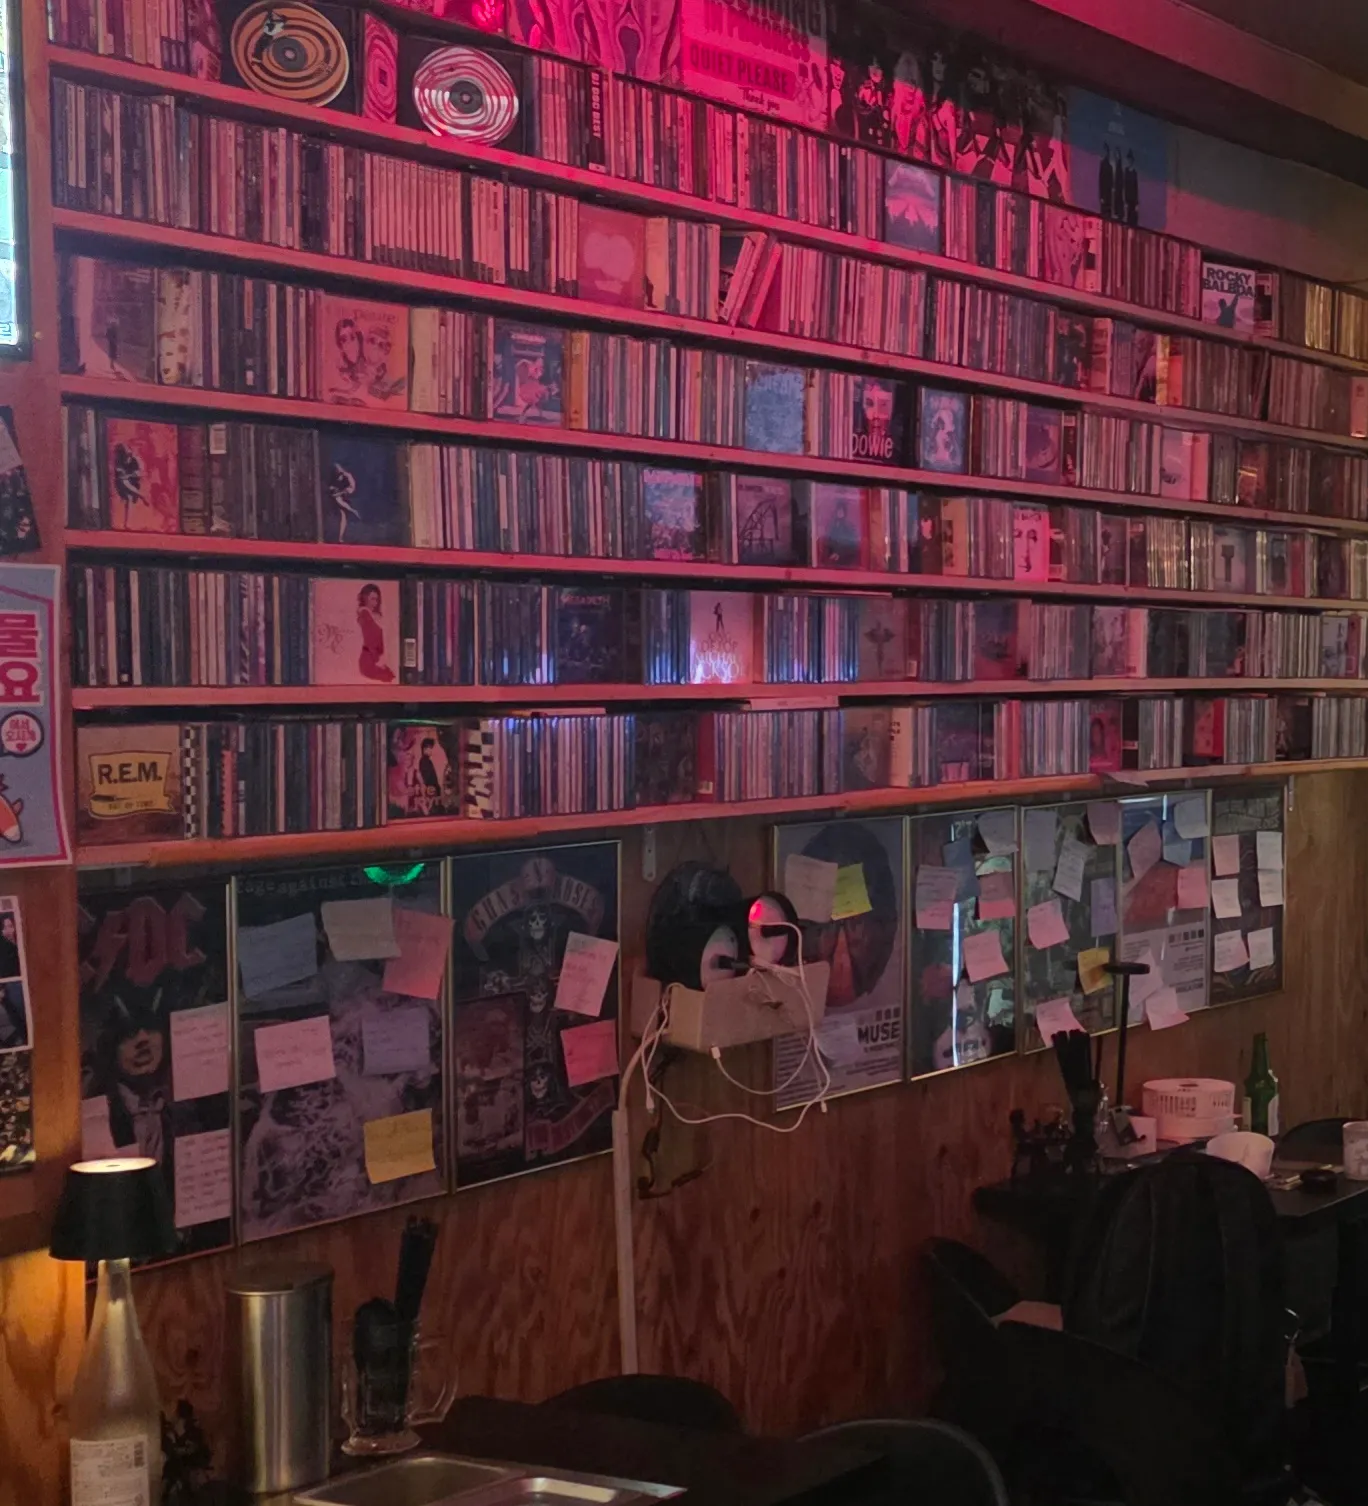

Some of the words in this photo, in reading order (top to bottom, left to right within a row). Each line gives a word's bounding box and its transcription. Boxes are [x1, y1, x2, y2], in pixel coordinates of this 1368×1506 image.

[690, 44, 732, 75] QUIET
[738, 58, 788, 95] PLEASE
[1207, 267, 1252, 285] ROCKY
[97, 761, 162, 786] R.E.M.
[857, 1021, 901, 1045] MUSE
